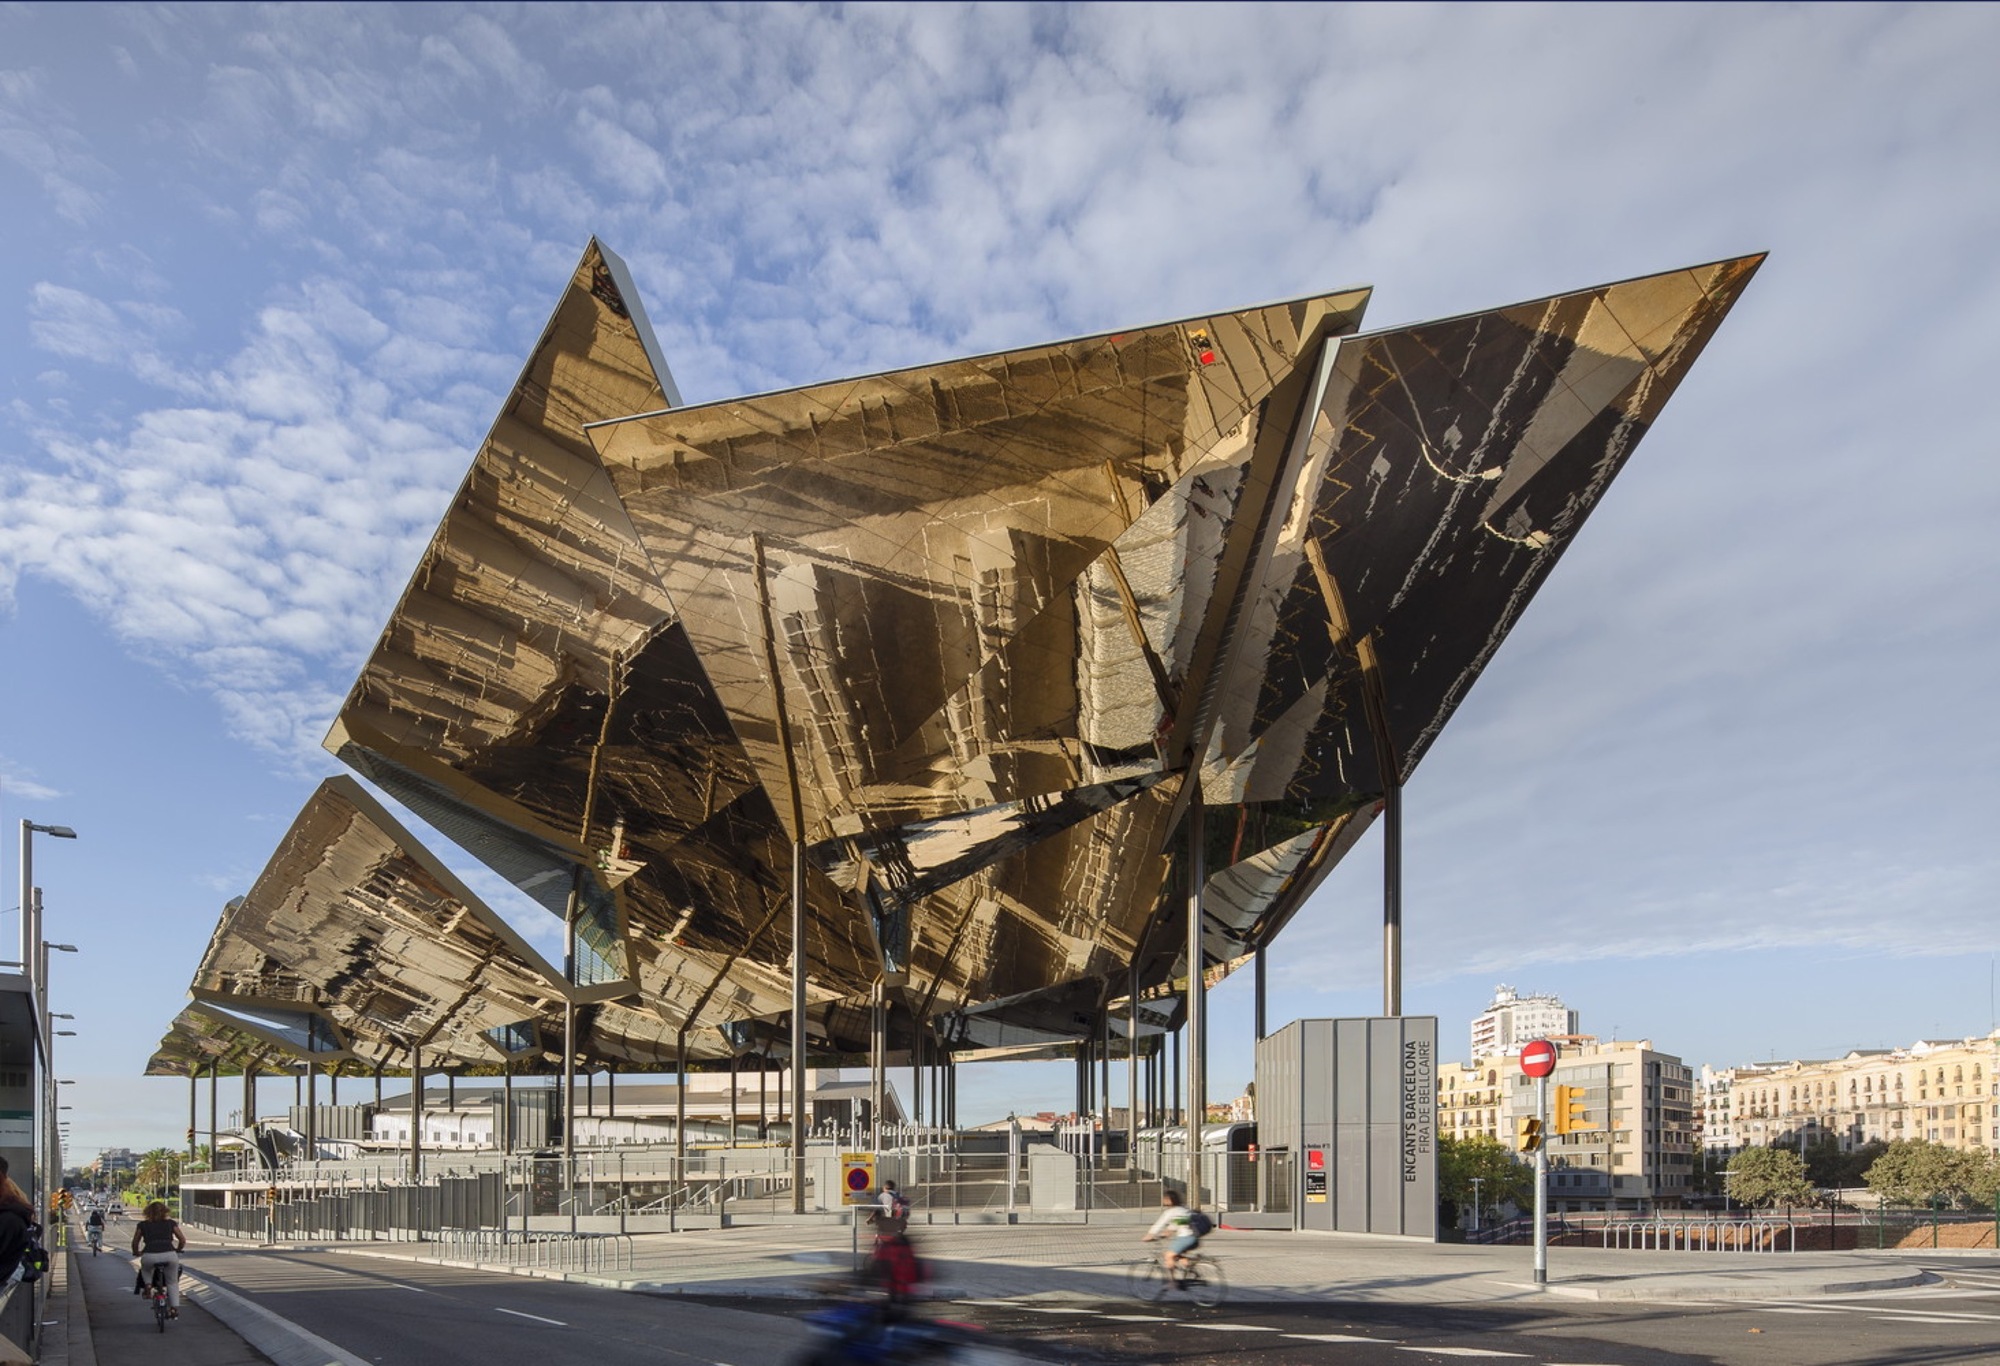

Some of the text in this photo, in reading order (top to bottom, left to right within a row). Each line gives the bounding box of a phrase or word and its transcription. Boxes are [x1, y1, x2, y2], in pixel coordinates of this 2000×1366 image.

[1405, 1041, 1416, 1182] ENCANTS BARCELONA
[1419, 1041, 1430, 1153] FIRA DE BELLCAIRE
